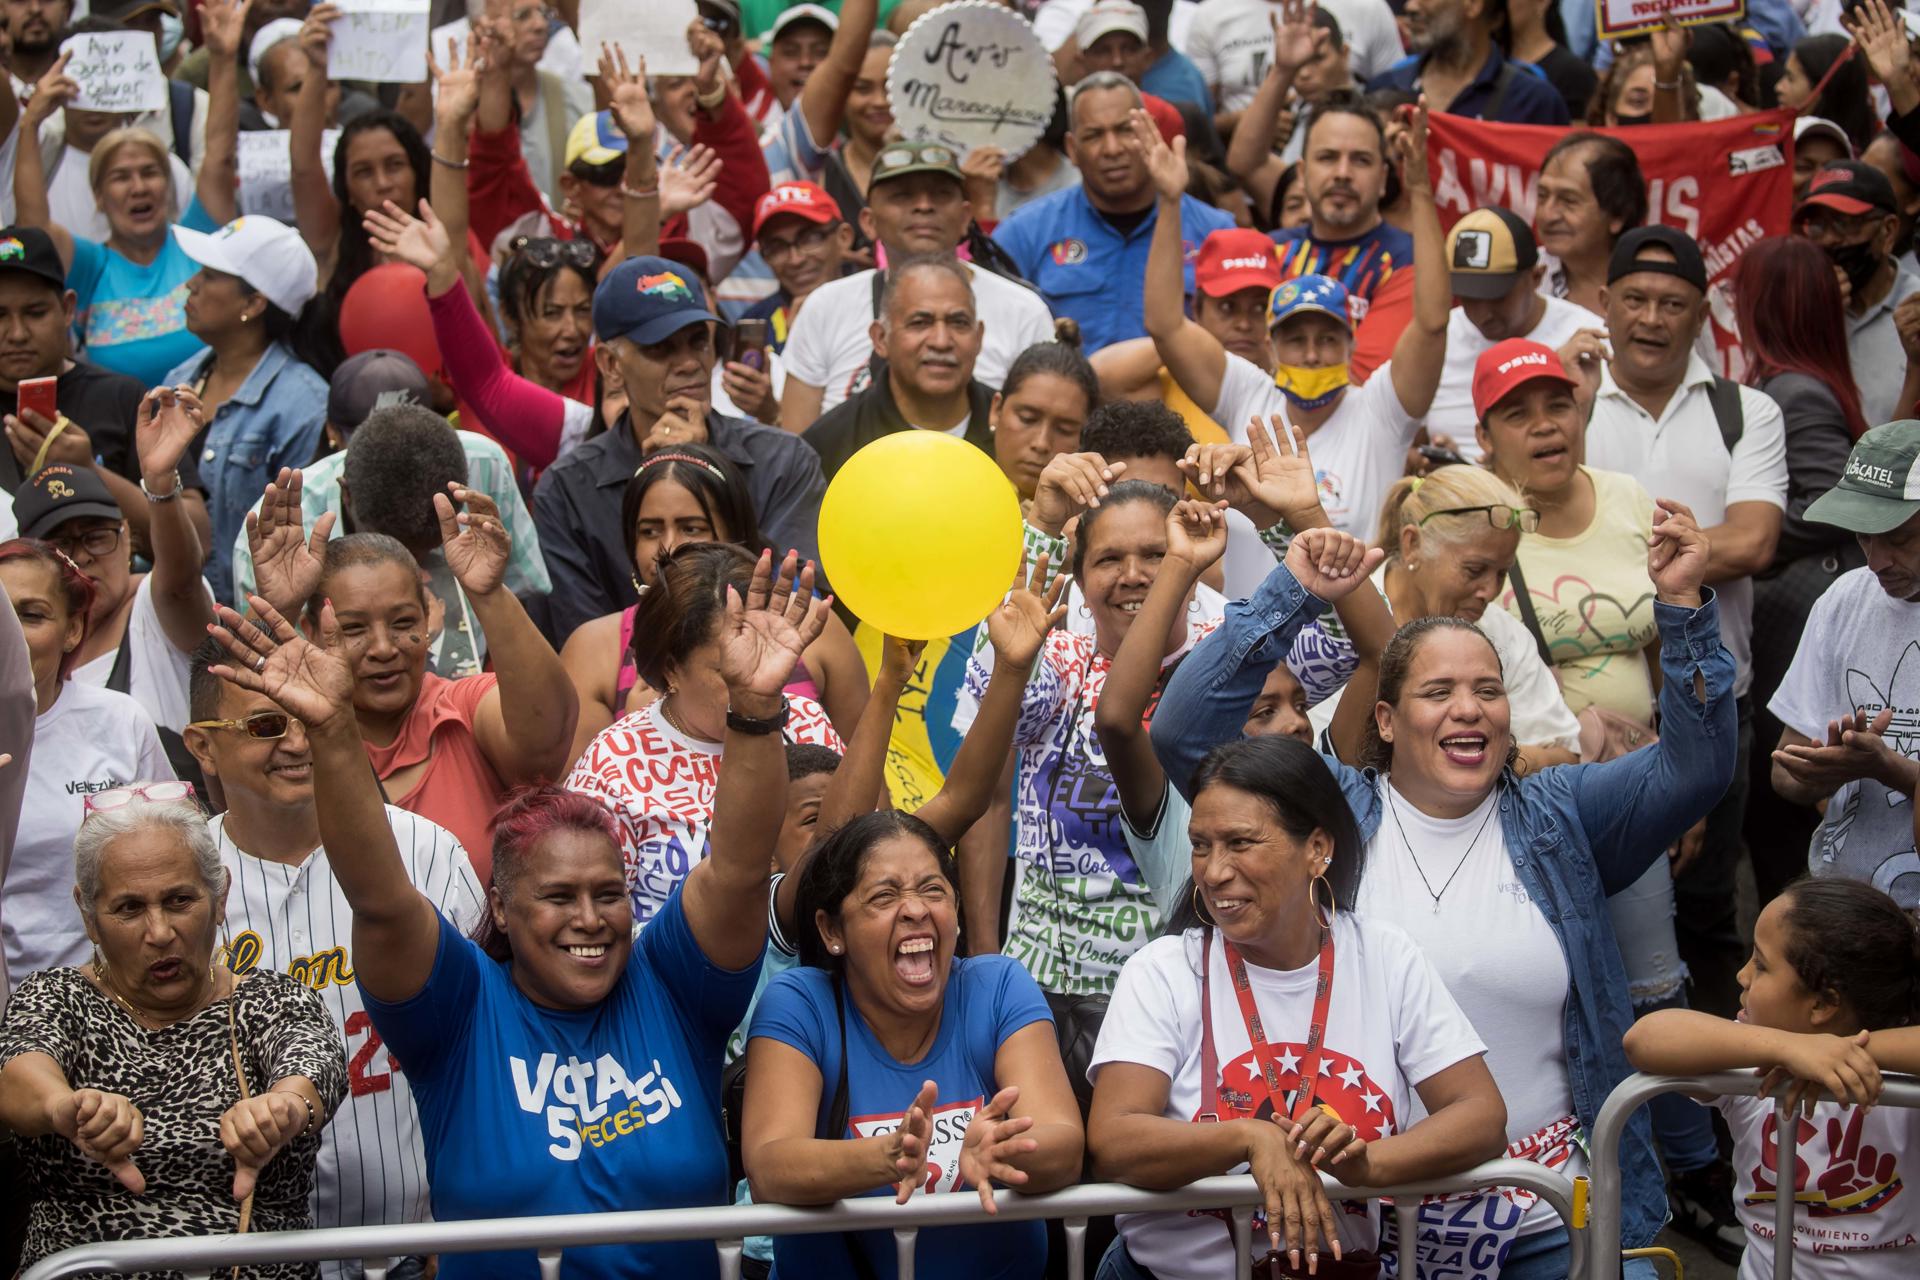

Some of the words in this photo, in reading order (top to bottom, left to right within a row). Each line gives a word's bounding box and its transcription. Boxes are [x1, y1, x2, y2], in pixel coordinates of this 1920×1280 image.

[546, 1105, 582, 1161] 5
[575, 1100, 646, 1148] VECES
[946, 1159, 958, 1182] JEANS
